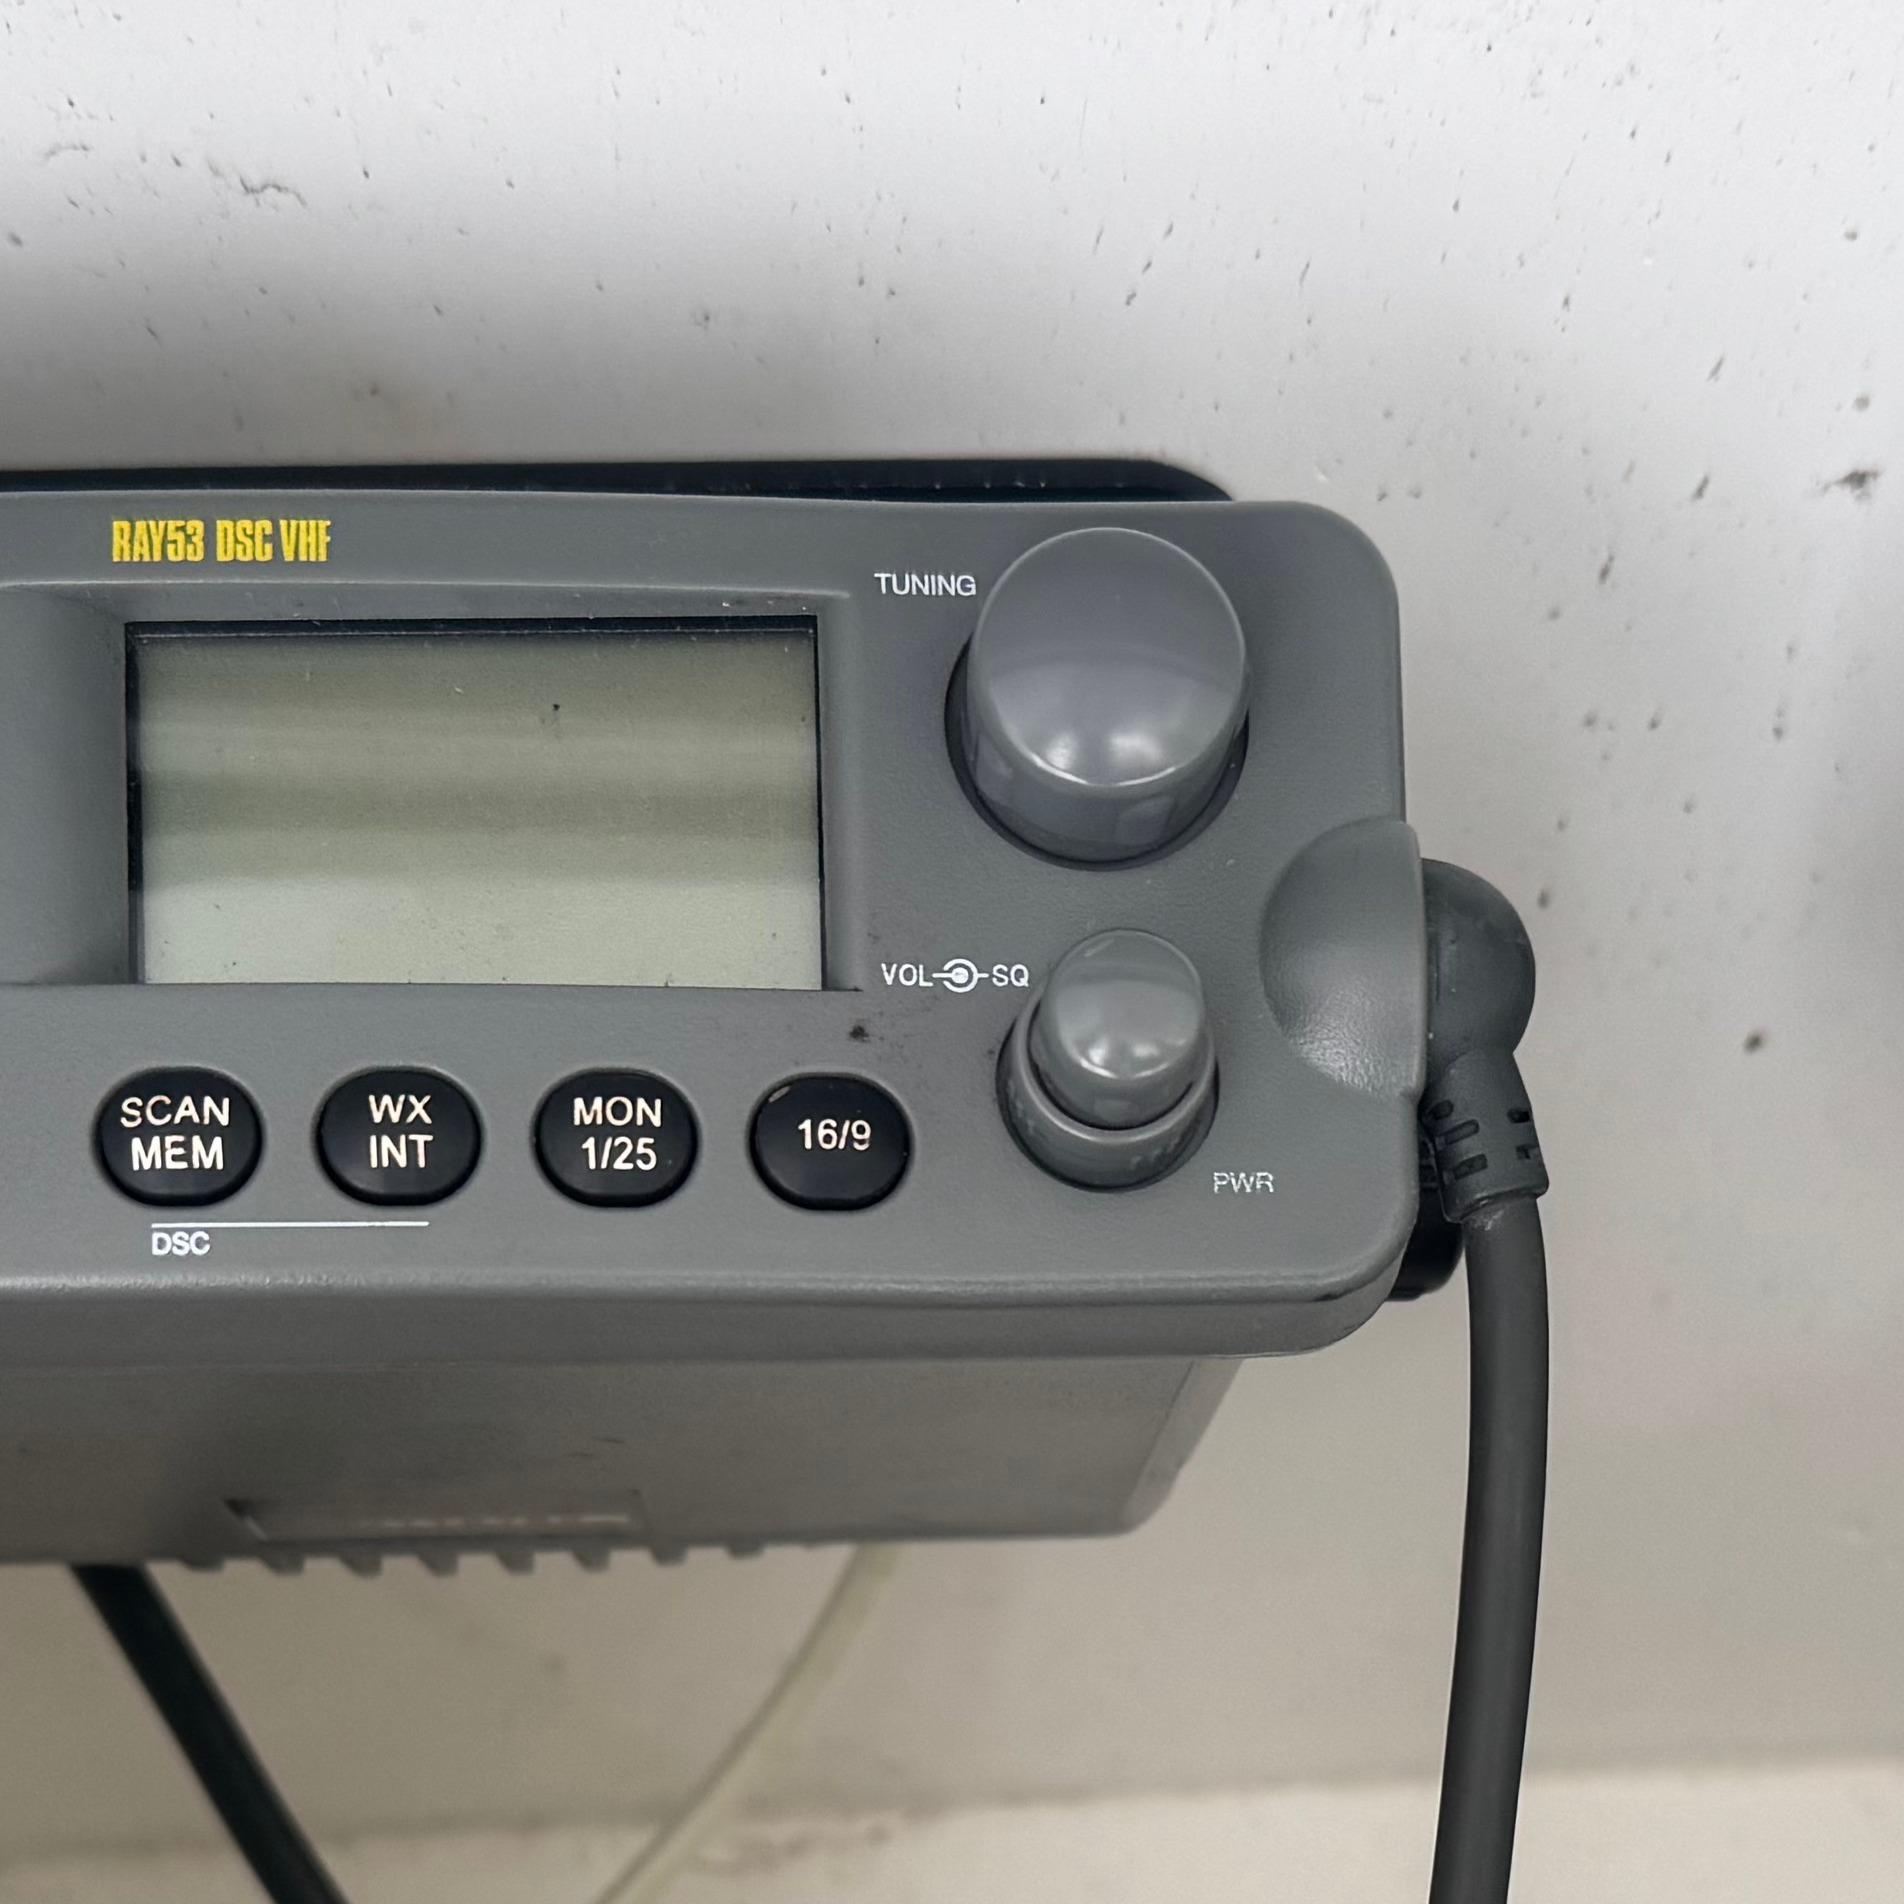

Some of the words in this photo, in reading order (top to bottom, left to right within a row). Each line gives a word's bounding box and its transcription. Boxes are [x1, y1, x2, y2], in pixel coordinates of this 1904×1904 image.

[110, 518, 205, 563] RAY53
[215, 518, 274, 563] DSC
[278, 518, 332, 563] VHF
[872, 571, 978, 599] TUNING
[880, 962, 933, 989] VOL
[991, 962, 1030, 989] SQ
[119, 1093, 232, 1129] SCAN
[366, 1093, 434, 1126] WX
[571, 1095, 664, 1129] MON
[367, 1133, 434, 1170] INT
[796, 1117, 872, 1153] 16/9
[129, 1134, 226, 1172] MEM
[580, 1135, 658, 1172] 1/25
[1212, 1171, 1276, 1194] PWR
[150, 1229, 212, 1258] DSC
